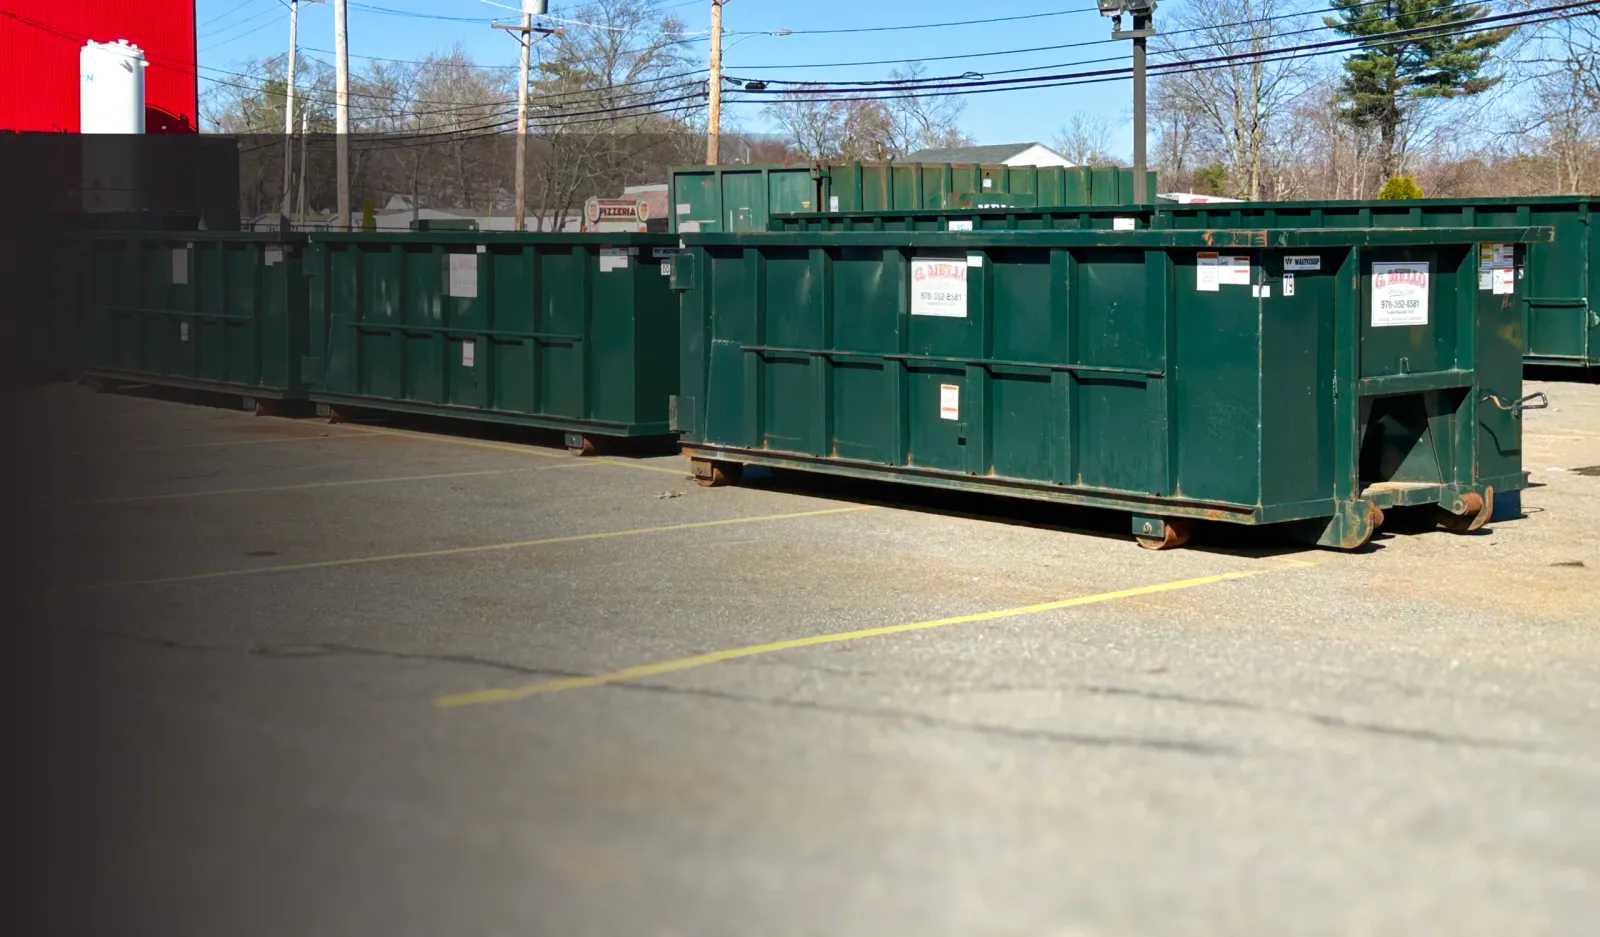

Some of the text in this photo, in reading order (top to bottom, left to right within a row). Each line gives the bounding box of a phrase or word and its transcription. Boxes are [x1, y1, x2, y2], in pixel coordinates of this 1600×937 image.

[599, 207, 636, 216] PIZZERIA
[920, 291, 962, 301] 978-352-8581
[1380, 299, 1420, 309] 978-352-8581
